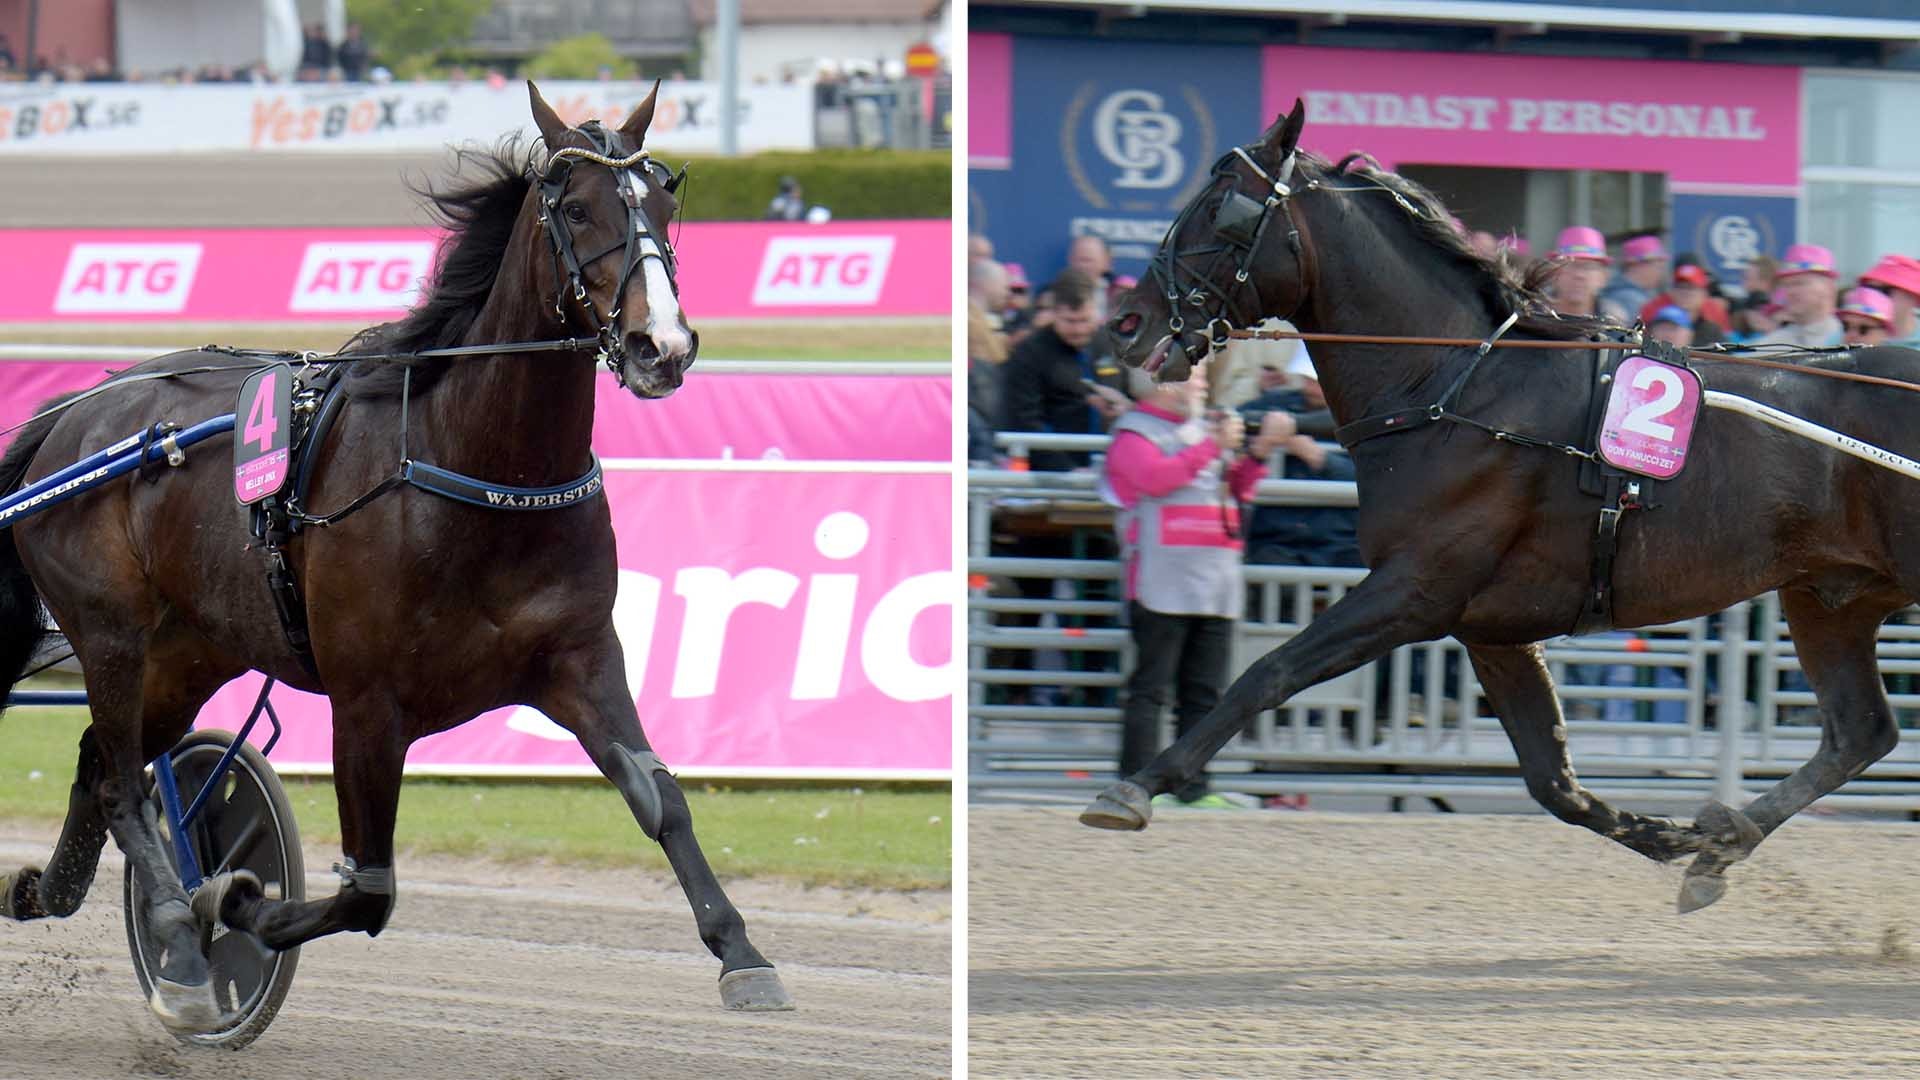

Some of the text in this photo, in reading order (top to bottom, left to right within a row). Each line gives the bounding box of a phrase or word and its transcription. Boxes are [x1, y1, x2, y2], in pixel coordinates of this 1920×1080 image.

[1303, 90, 1766, 140] ENDAST PERSONAL
[73, 261, 178, 294] ATG
[307, 259, 414, 293] ATG
[769, 253, 872, 287] ATG
[243, 371, 278, 453] 4
[1621, 366, 1685, 442] 2
[1659, 458, 1675, 470] ZET
